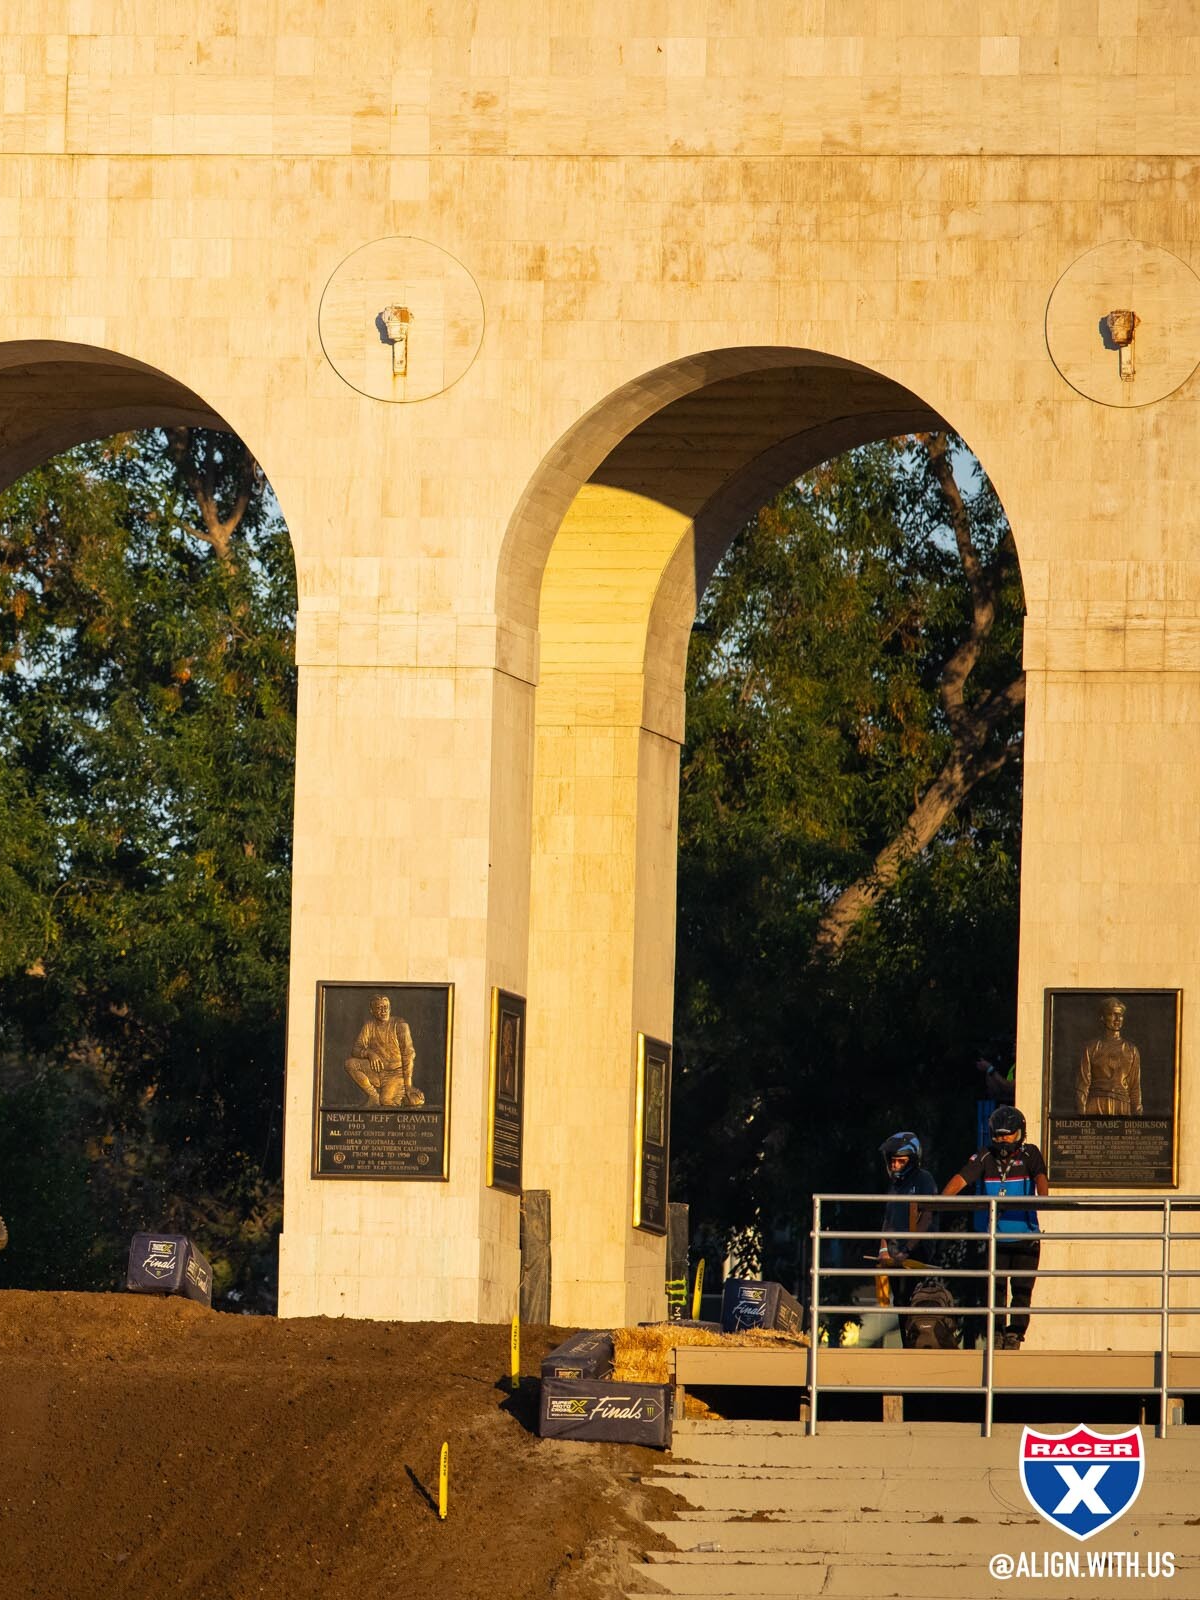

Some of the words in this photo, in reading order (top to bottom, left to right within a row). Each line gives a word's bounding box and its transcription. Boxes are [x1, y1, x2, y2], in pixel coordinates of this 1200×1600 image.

[326, 1113, 364, 1122] NEWELL
[396, 1114, 438, 1124] CRAVATH
[1055, 1120, 1091, 1128] MILDRED
[1124, 1120, 1168, 1129] DIDRIKSON
[142, 1254, 176, 1270] Finals
[732, 1300, 767, 1316] Finals
[589, 1396, 642, 1420] Finals
